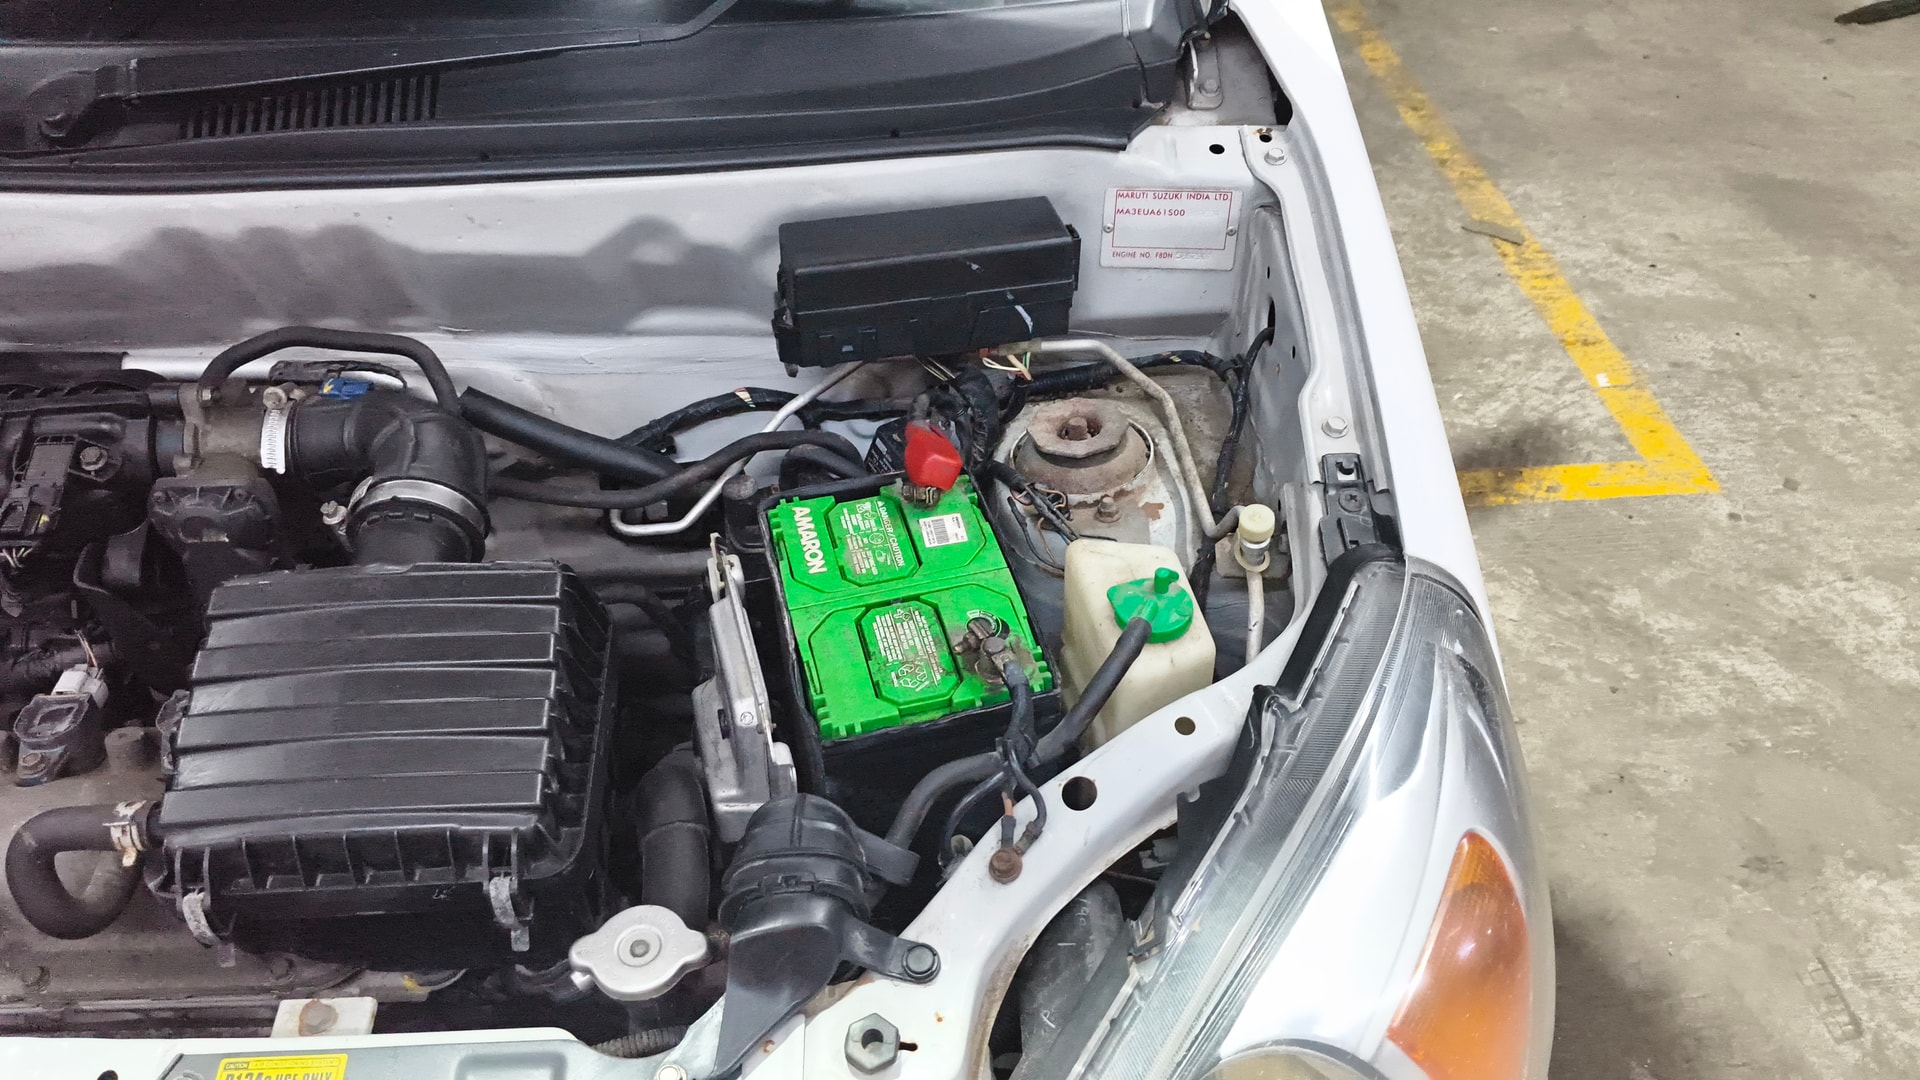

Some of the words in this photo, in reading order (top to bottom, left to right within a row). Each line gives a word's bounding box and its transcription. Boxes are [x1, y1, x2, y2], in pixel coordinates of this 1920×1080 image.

[1152, 192, 1182, 200] SUZUKI
[1214, 193, 1229, 201] LTD
[792, 506, 828, 575] AMARON
[879, 507, 894, 534] DANGER
[889, 537, 905, 567] CAUTION
